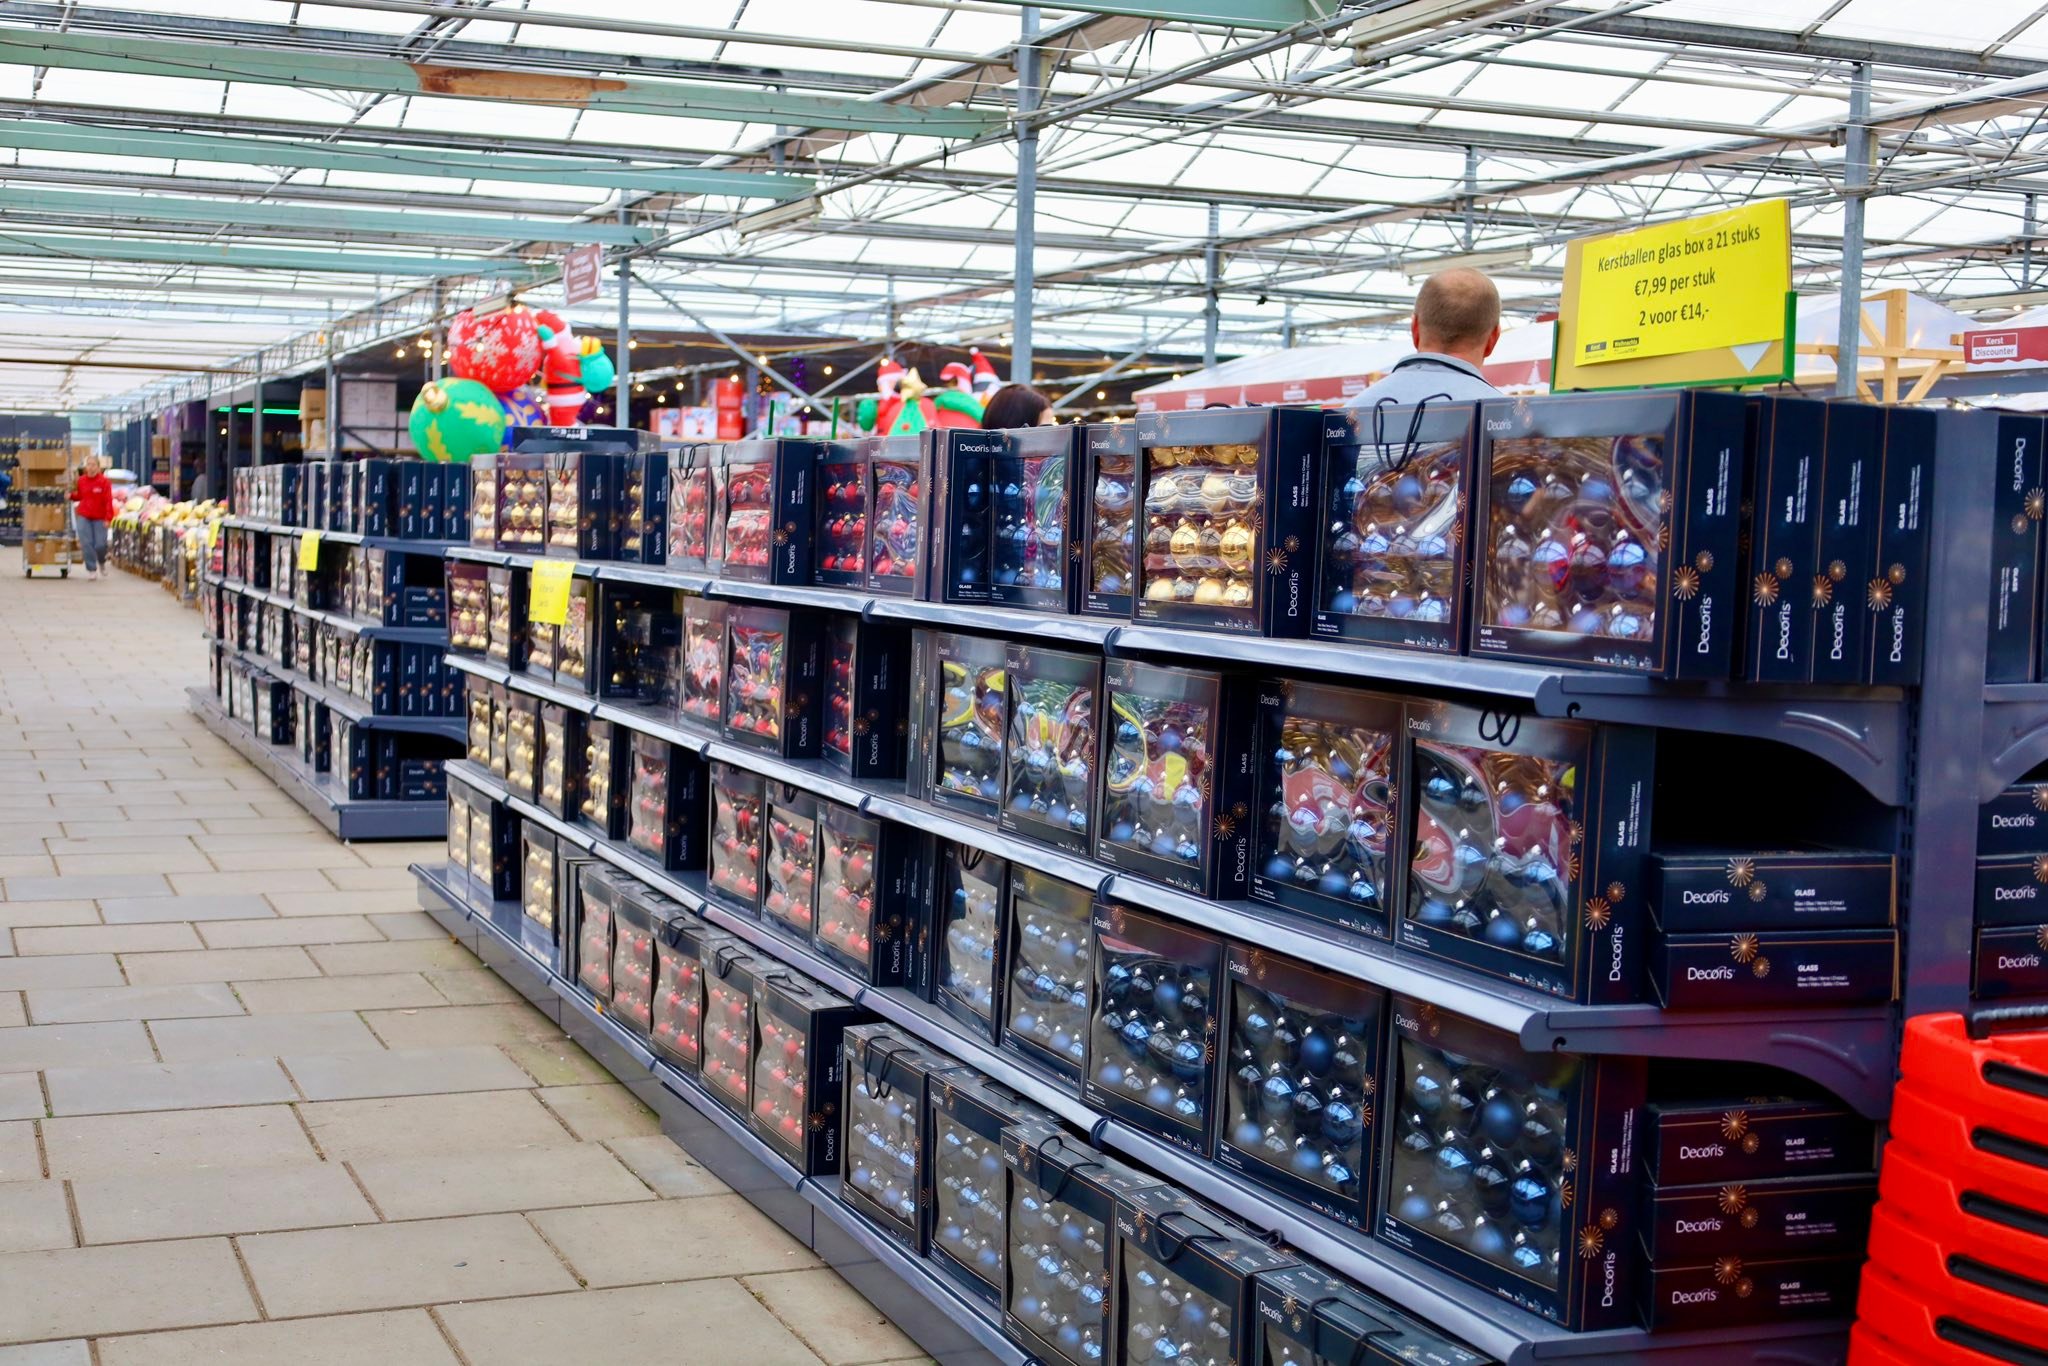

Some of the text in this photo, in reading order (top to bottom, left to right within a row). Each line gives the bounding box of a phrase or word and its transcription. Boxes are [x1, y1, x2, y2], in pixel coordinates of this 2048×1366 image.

[1598, 224, 1760, 272] Kerstballen glas box a 21 stuks
[1634, 268, 1716, 297] €7,99 per stuk
[1639, 302, 1710, 326] 2 voor €14,-
[1975, 348, 2014, 357] Discounter
[1326, 428, 1346, 438] Decoris
[1487, 419, 1512, 431] Decoris
[960, 444, 990, 452] Decoris
[1092, 441, 1110, 450] Decoris
[2014, 438, 2026, 492] Decoris
[1706, 488, 1714, 516] GLASS
[1786, 496, 1794, 523] GLASS
[1838, 500, 1846, 526] GLASS
[1288, 570, 1299, 617] Decoris
[1698, 595, 1712, 654] Decoris
[1777, 602, 1791, 660] Decoris
[1831, 603, 1844, 660] Decoris
[1890, 606, 1904, 662] Decoris
[1108, 676, 1122, 686] Decoris
[1260, 694, 1279, 706] Decoris
[1408, 718, 1431, 731] Decoris
[870, 734, 878, 765] Decoris
[1992, 814, 2036, 828] Decoris
[1234, 838, 1246, 882] Decoris
[1683, 890, 1730, 904] Decoris
[1995, 886, 2036, 900] Decoris
[1094, 916, 1112, 930] Decoris
[891, 940, 900, 973] Decoris
[1610, 926, 1623, 982] Decoris
[1998, 954, 2040, 970] Decoris
[1229, 960, 1249, 975] Decoris
[1688, 966, 1734, 980] Decoris
[1396, 1014, 1420, 1032] Decoris
[826, 1128, 834, 1161] Decoris
[1786, 1138, 1806, 1146] GLASS
[1004, 1149, 1018, 1166] Decoris
[1680, 1144, 1724, 1160] Decoris
[1786, 1213, 1806, 1221] GLASS
[1118, 1218, 1134, 1236] Decoris
[1676, 1218, 1722, 1234] Decoris
[1602, 1252, 1616, 1307] Decoris
[1780, 1282, 1800, 1290] GLASS
[1672, 1289, 1718, 1304] Decoris
[1260, 1302, 1283, 1324] Decoris
